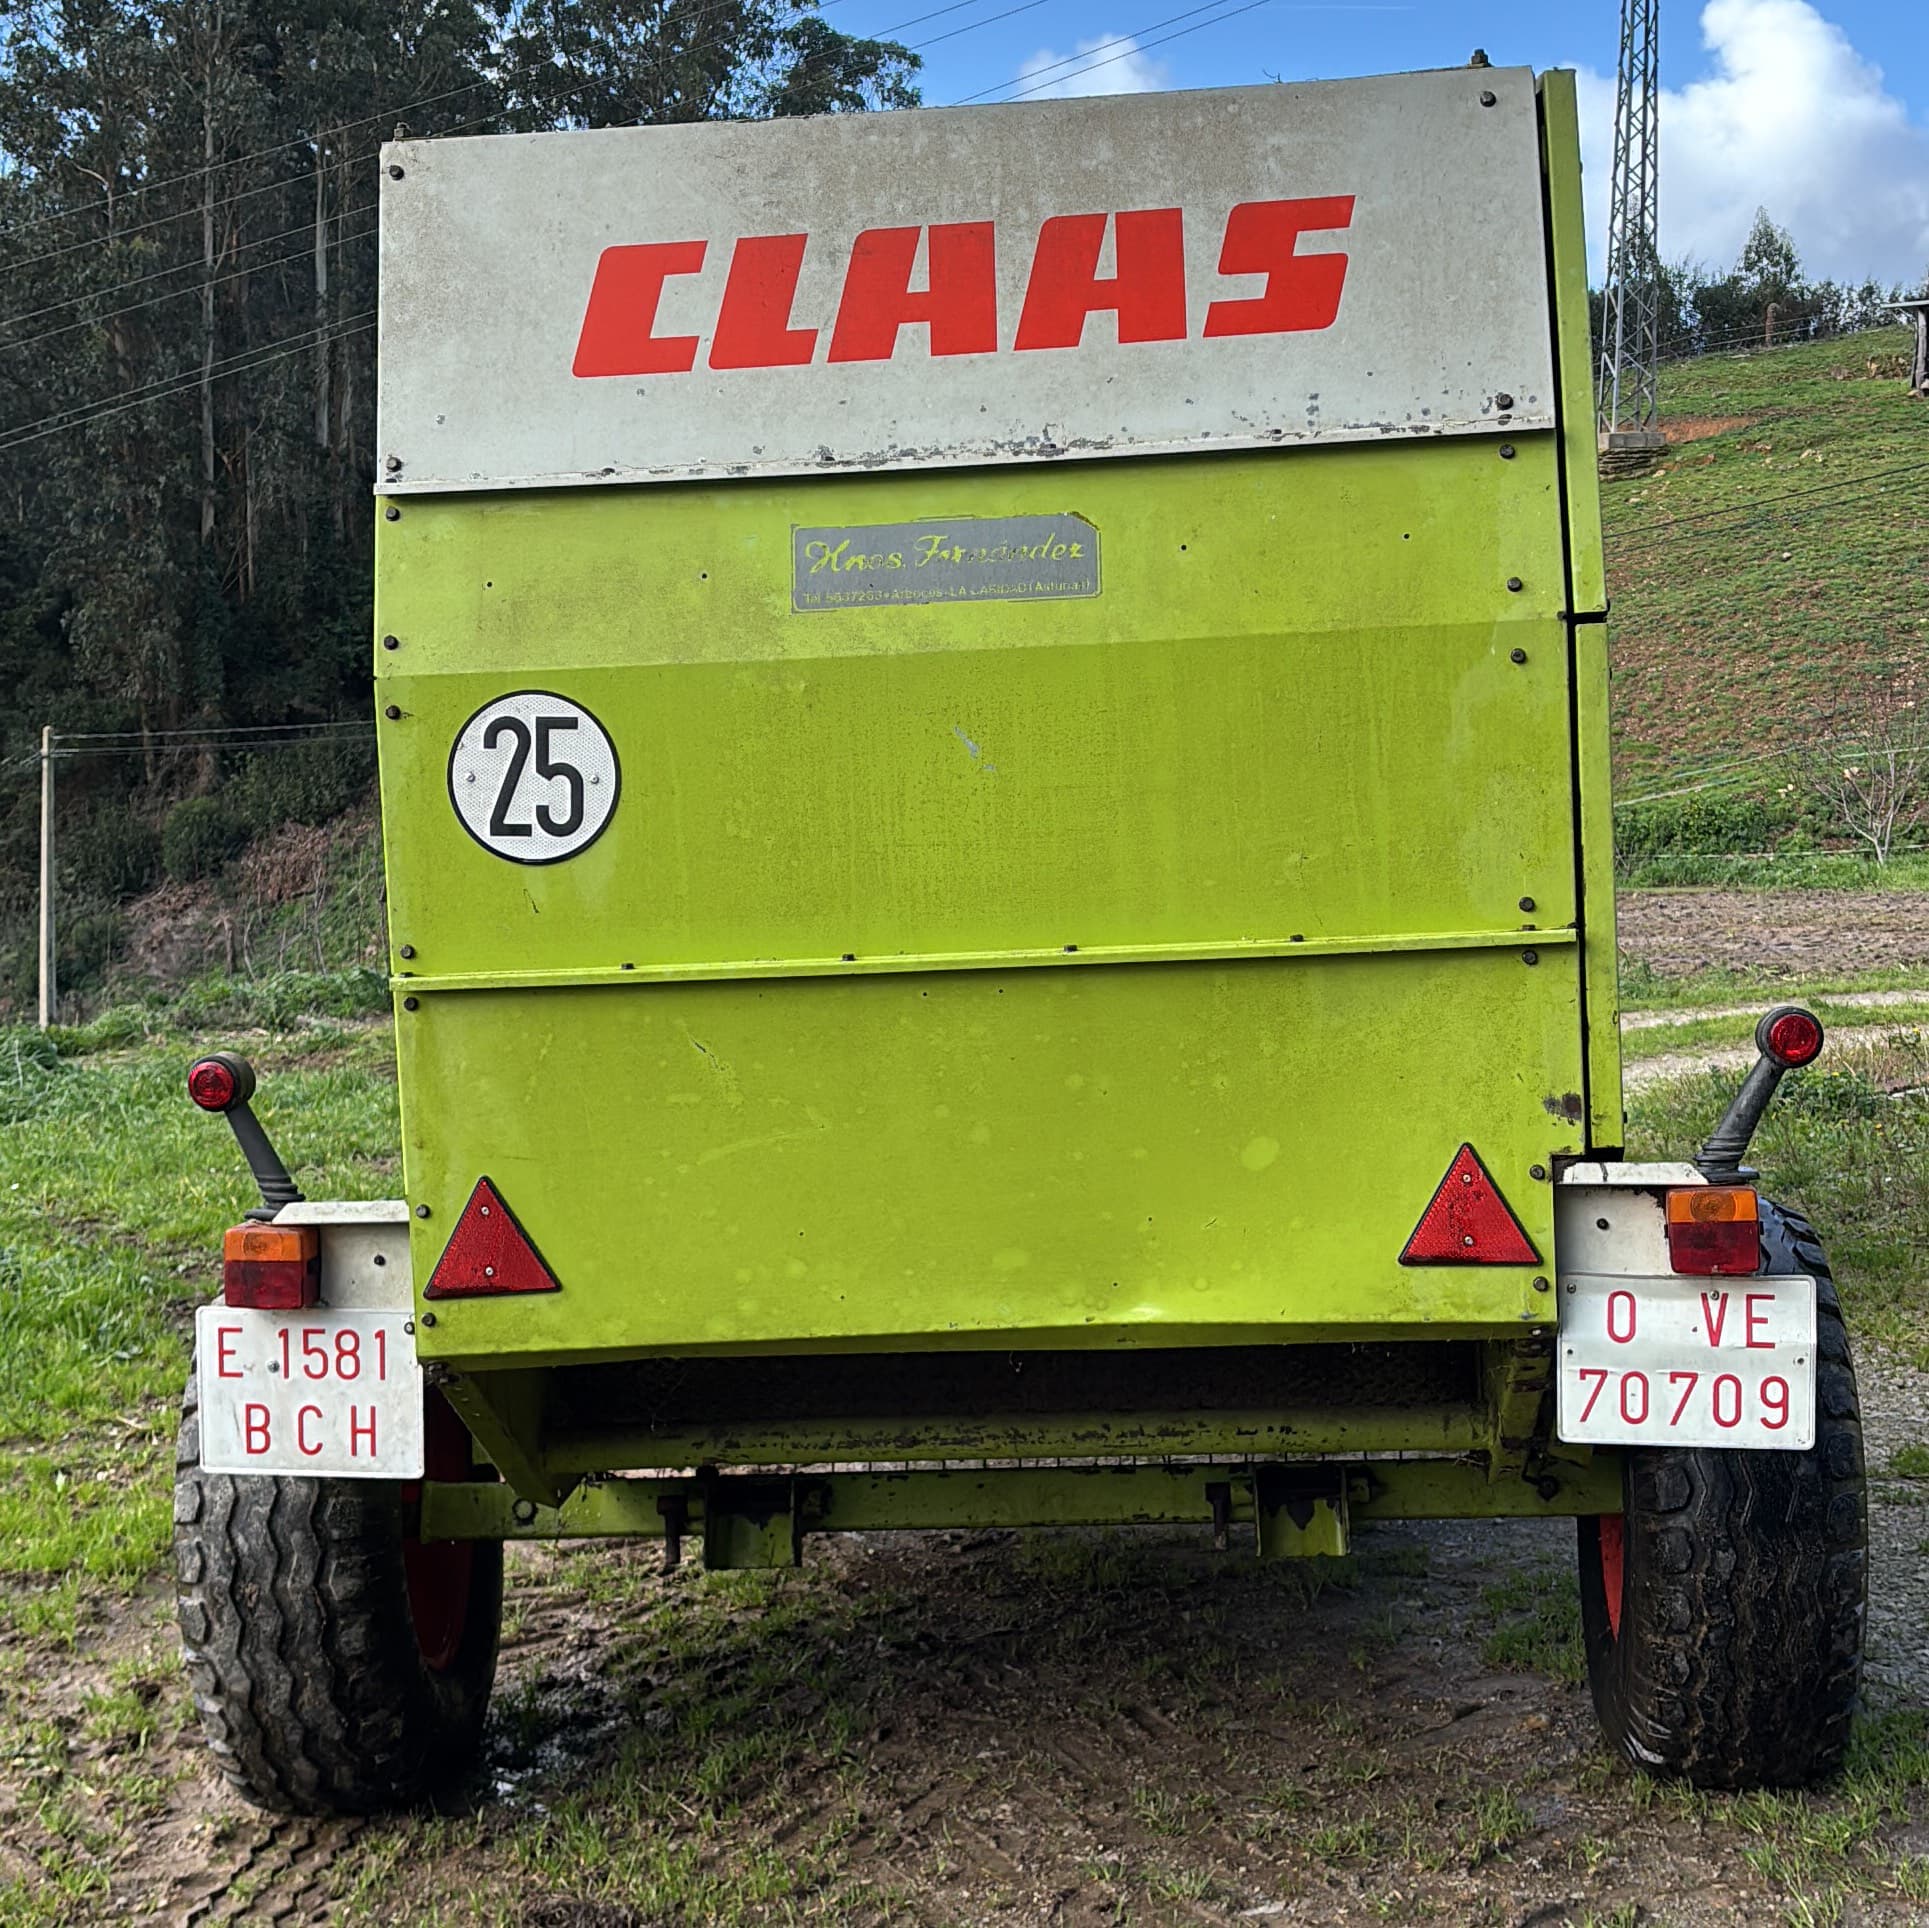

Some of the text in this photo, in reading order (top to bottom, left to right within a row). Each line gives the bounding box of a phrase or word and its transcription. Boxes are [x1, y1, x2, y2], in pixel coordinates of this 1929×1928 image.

[572, 195, 1356, 378] CLAAS
[484, 716, 584, 838] 25
[1700, 1292, 1776, 1349] VE
[217, 1327, 386, 1381] E 1581
[1578, 1368, 1790, 1430] 70709
